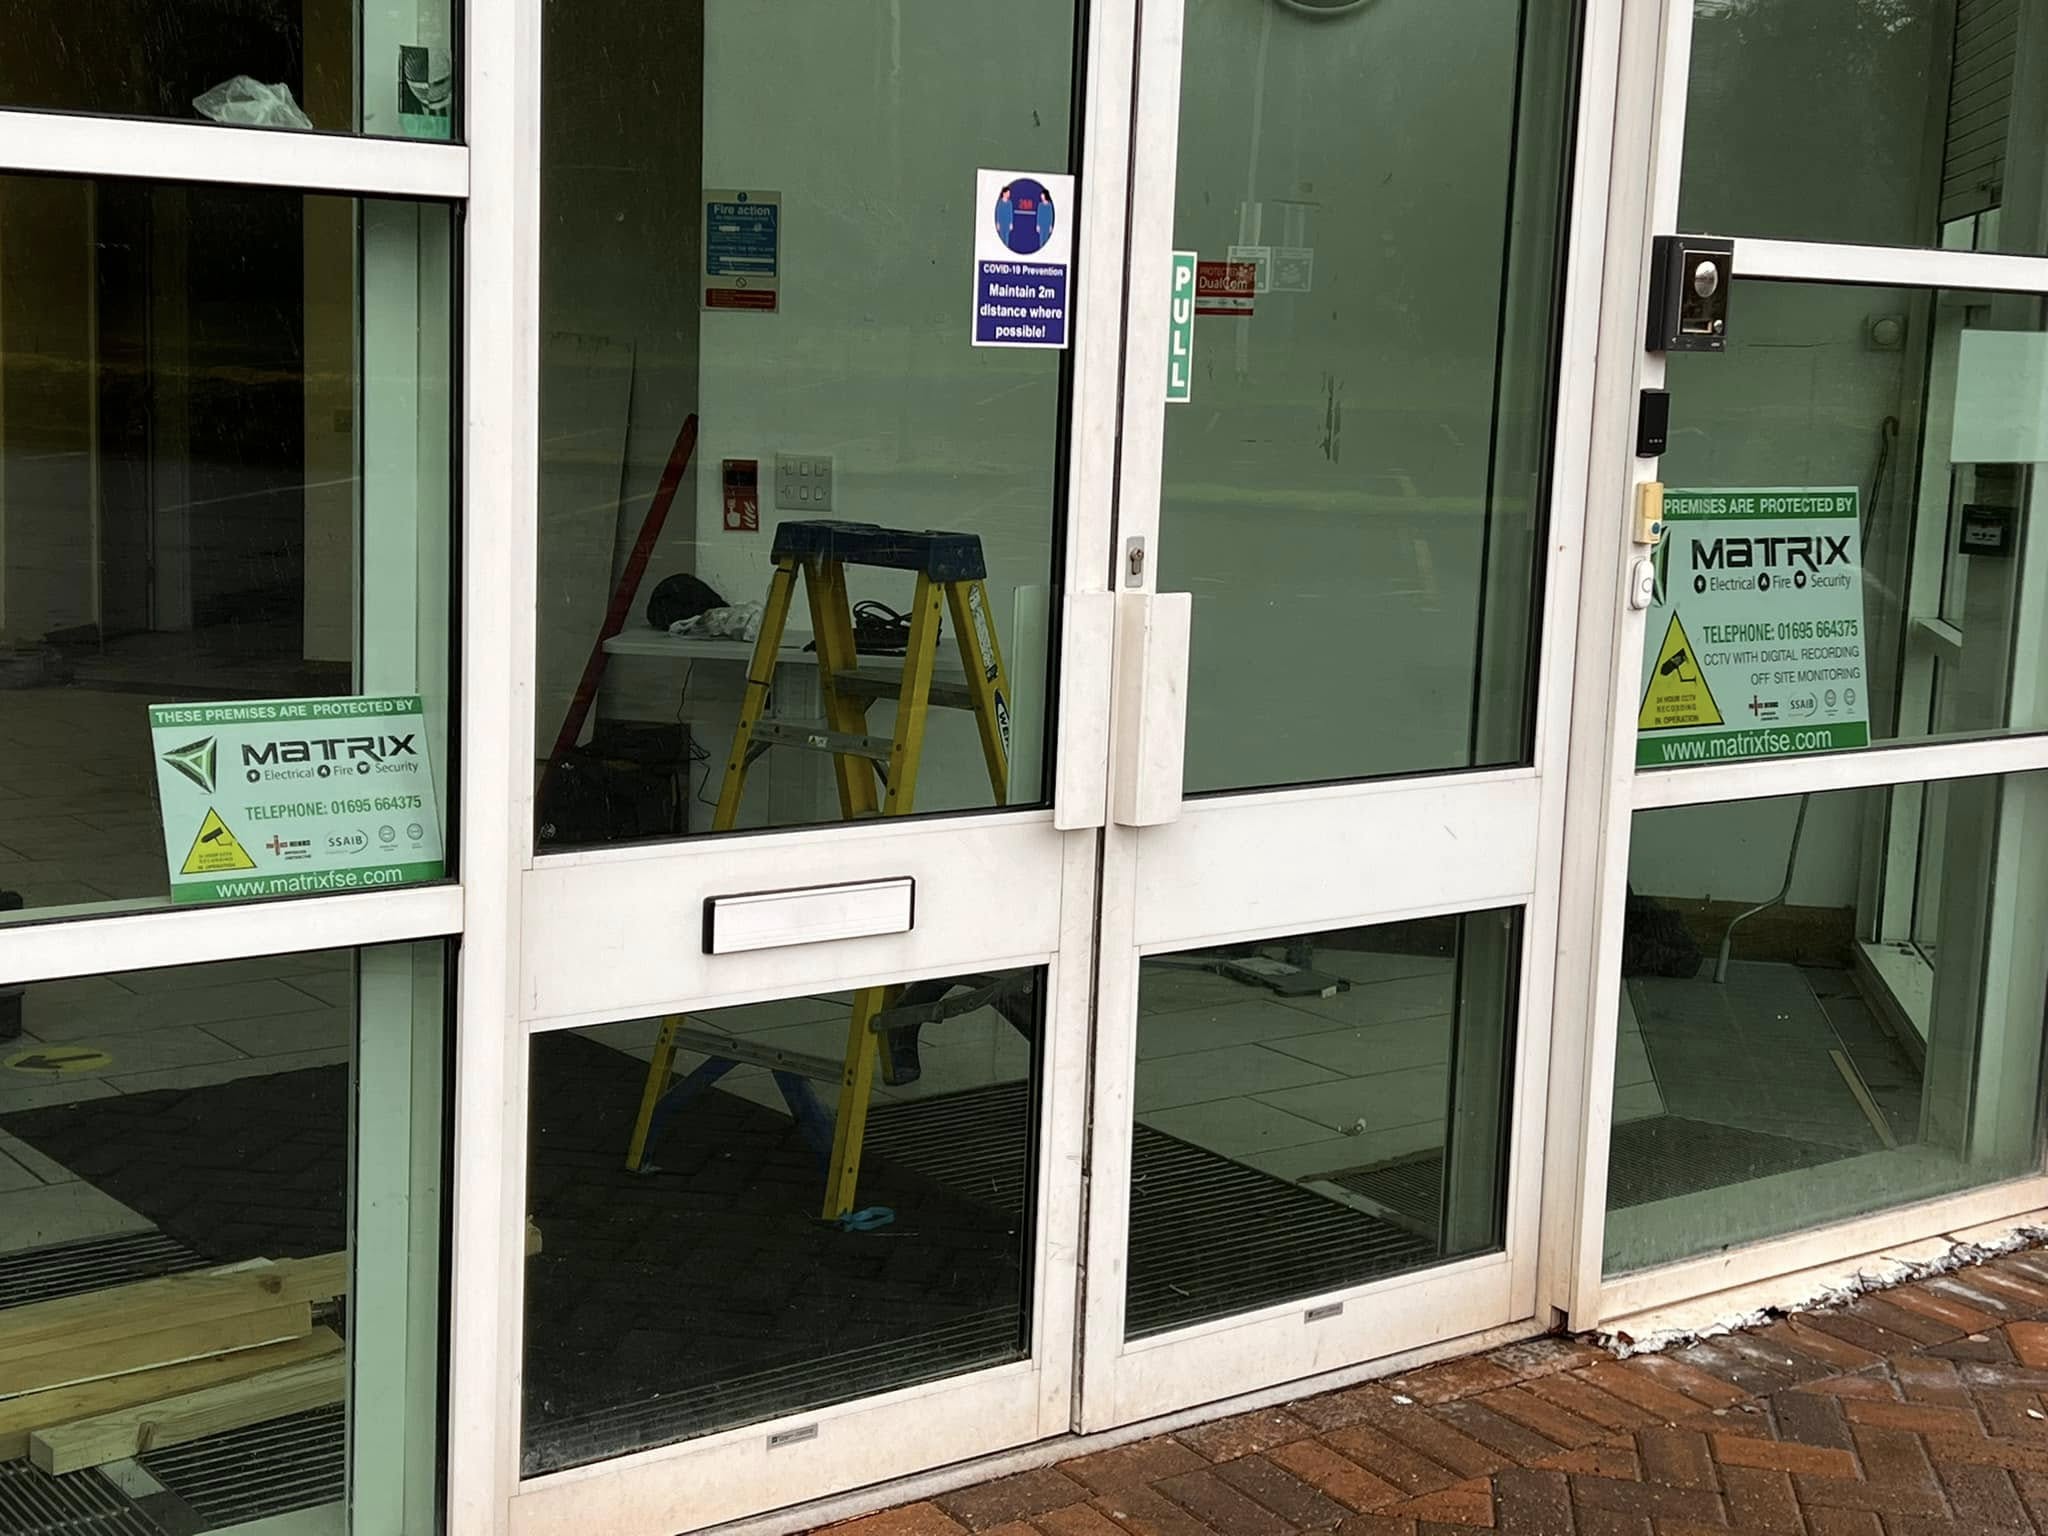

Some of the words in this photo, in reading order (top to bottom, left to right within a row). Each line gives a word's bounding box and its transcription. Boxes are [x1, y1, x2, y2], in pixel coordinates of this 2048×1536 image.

[713, 204, 734, 214] Fire
[737, 206, 771, 216] action
[983, 263, 1020, 275] COVID-19
[1022, 265, 1064, 276] Prevention
[989, 283, 1036, 298] Maintain
[1038, 285, 1055, 299] 2m
[1199, 276, 1248, 290] DualCom
[980, 303, 1027, 318] distance
[1029, 305, 1063, 319] where
[995, 324, 1046, 339] possible!
[1171, 265, 1191, 388] PULL
[1663, 498, 1727, 514] PREMISES
[1728, 498, 1755, 514] ARE
[1760, 497, 1834, 514] PROTECTED
[1836, 496, 1853, 512] BY
[1709, 575, 1756, 591] Electrical
[1772, 575, 1792, 590] Fire
[1810, 573, 1852, 590] Security
[1702, 623, 1775, 644] TELEPHONE:
[1777, 621, 1814, 641] 01695
[1816, 619, 1858, 638] 664375
[1703, 652, 1732, 666] CCTV
[1732, 651, 1759, 665] WITH
[1760, 649, 1799, 663] DIGITAL
[1801, 645, 1860, 660] RECORDING
[1750, 672, 1770, 686] OFF
[1773, 671, 1796, 685] SITE
[1797, 667, 1861, 683] MONITORING
[155, 709, 202, 723] THESE
[205, 706, 277, 721] PREMISES
[279, 704, 307, 717] ARE
[312, 700, 397, 716] PROTECTED
[396, 699, 414, 711] BY
[1790, 699, 1814, 710] SSAIB
[1662, 729, 1832, 761] www.matrixfse.com
[263, 767, 315, 781] Electrical
[333, 765, 354, 777] Fire
[375, 760, 419, 774] Security
[245, 801, 328, 820] TELEPHONE:
[331, 798, 372, 815] 01695
[374, 795, 422, 812] 664375
[327, 835, 363, 848] SSAIB
[215, 868, 403, 898] www.matrixfse.com
